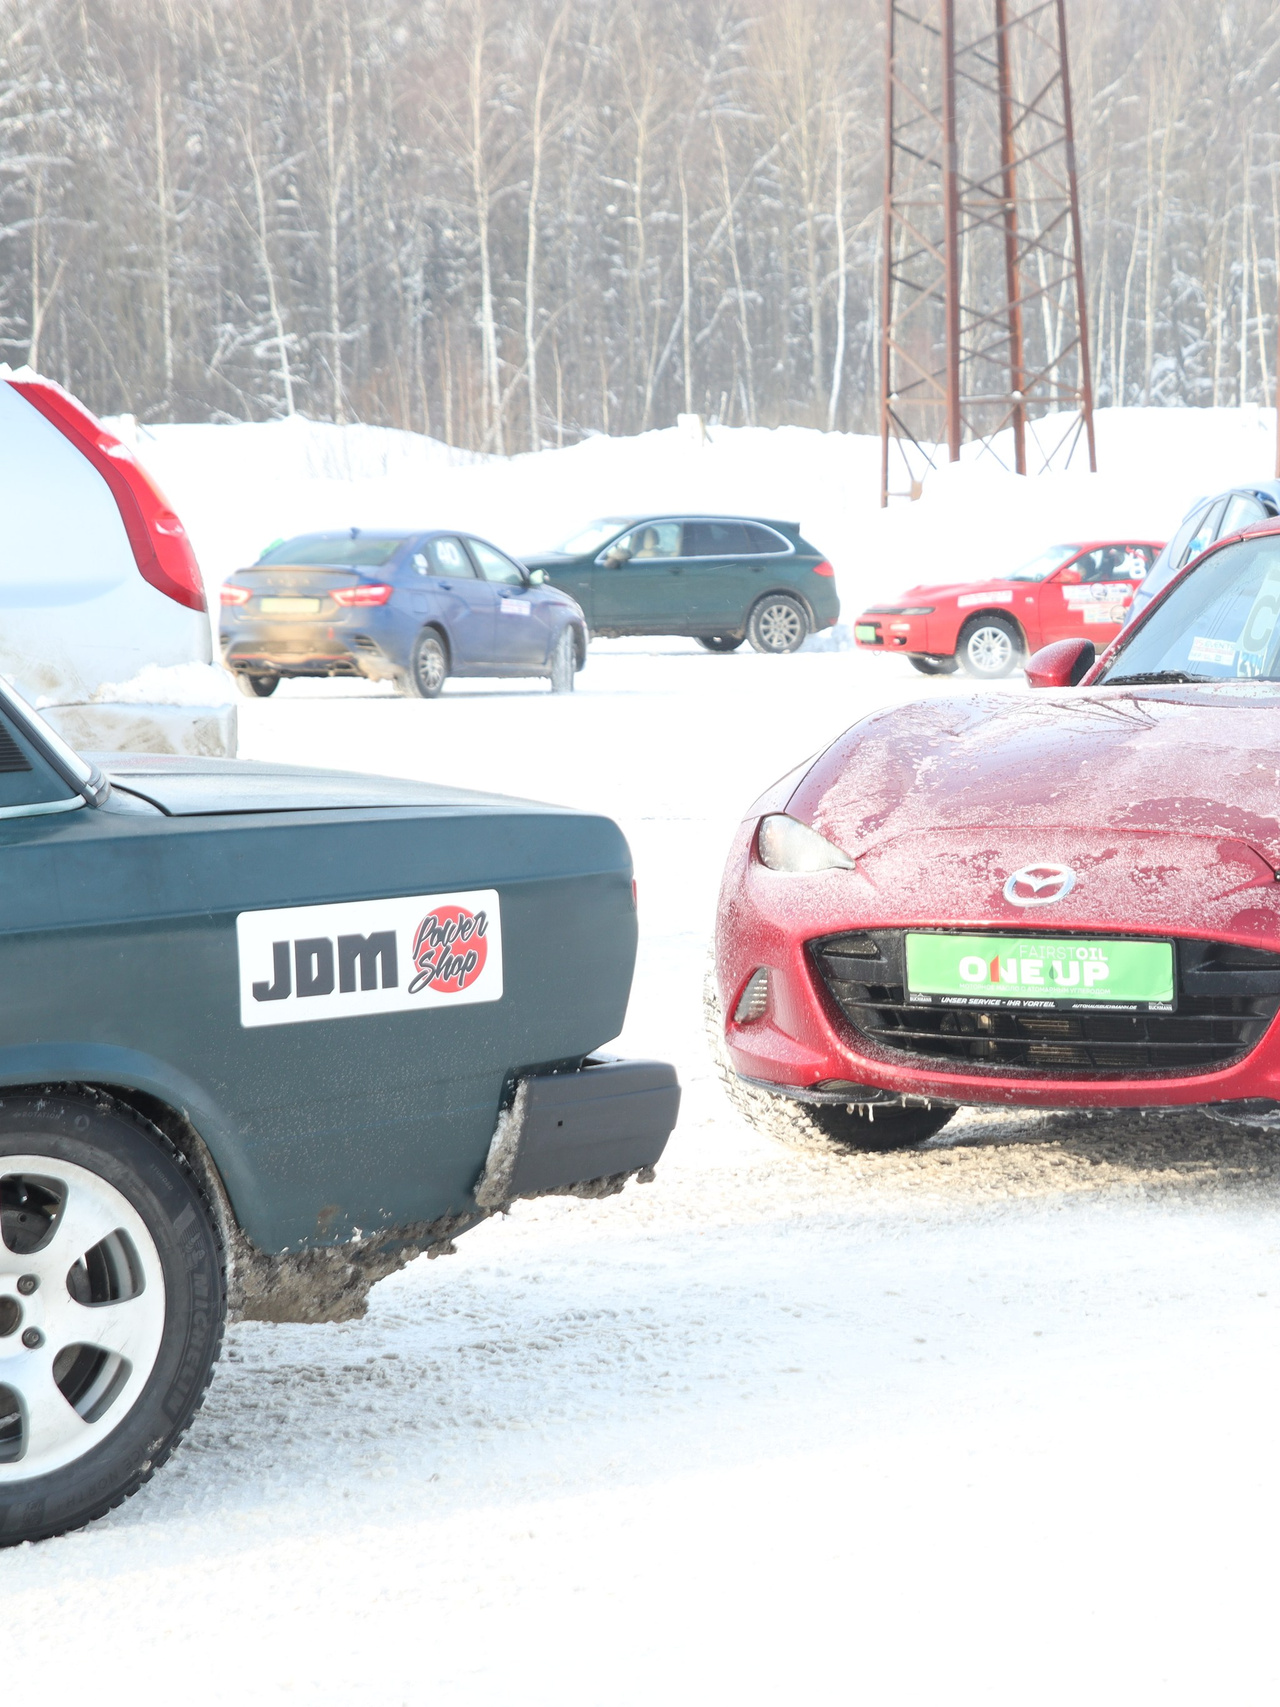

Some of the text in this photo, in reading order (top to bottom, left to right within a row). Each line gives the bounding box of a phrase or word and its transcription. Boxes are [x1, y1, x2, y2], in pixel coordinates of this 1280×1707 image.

[436, 541, 460, 566] 40
[412, 910, 488, 960] Power
[252, 929, 399, 1002] JDM
[1019, 945, 1108, 961] FAIRSTOIL
[408, 945, 478, 994] Shop
[959, 955, 1110, 987] ONE UP
[941, 996, 967, 1004] UNSER
[968, 997, 1000, 1006] SERVICE
[1007, 999, 1021, 1007] IHR
[1022, 1000, 1056, 1008] VORTEIL
[959, 983, 995, 991] МОТОРНОЕ
[996, 984, 1019, 992] МАСЛО
[1070, 987, 1111, 995] УГЛЕРОДОМ
[22, 1110, 61, 1120] ROTATION
[166, 1273, 208, 1412] MICHELIN
